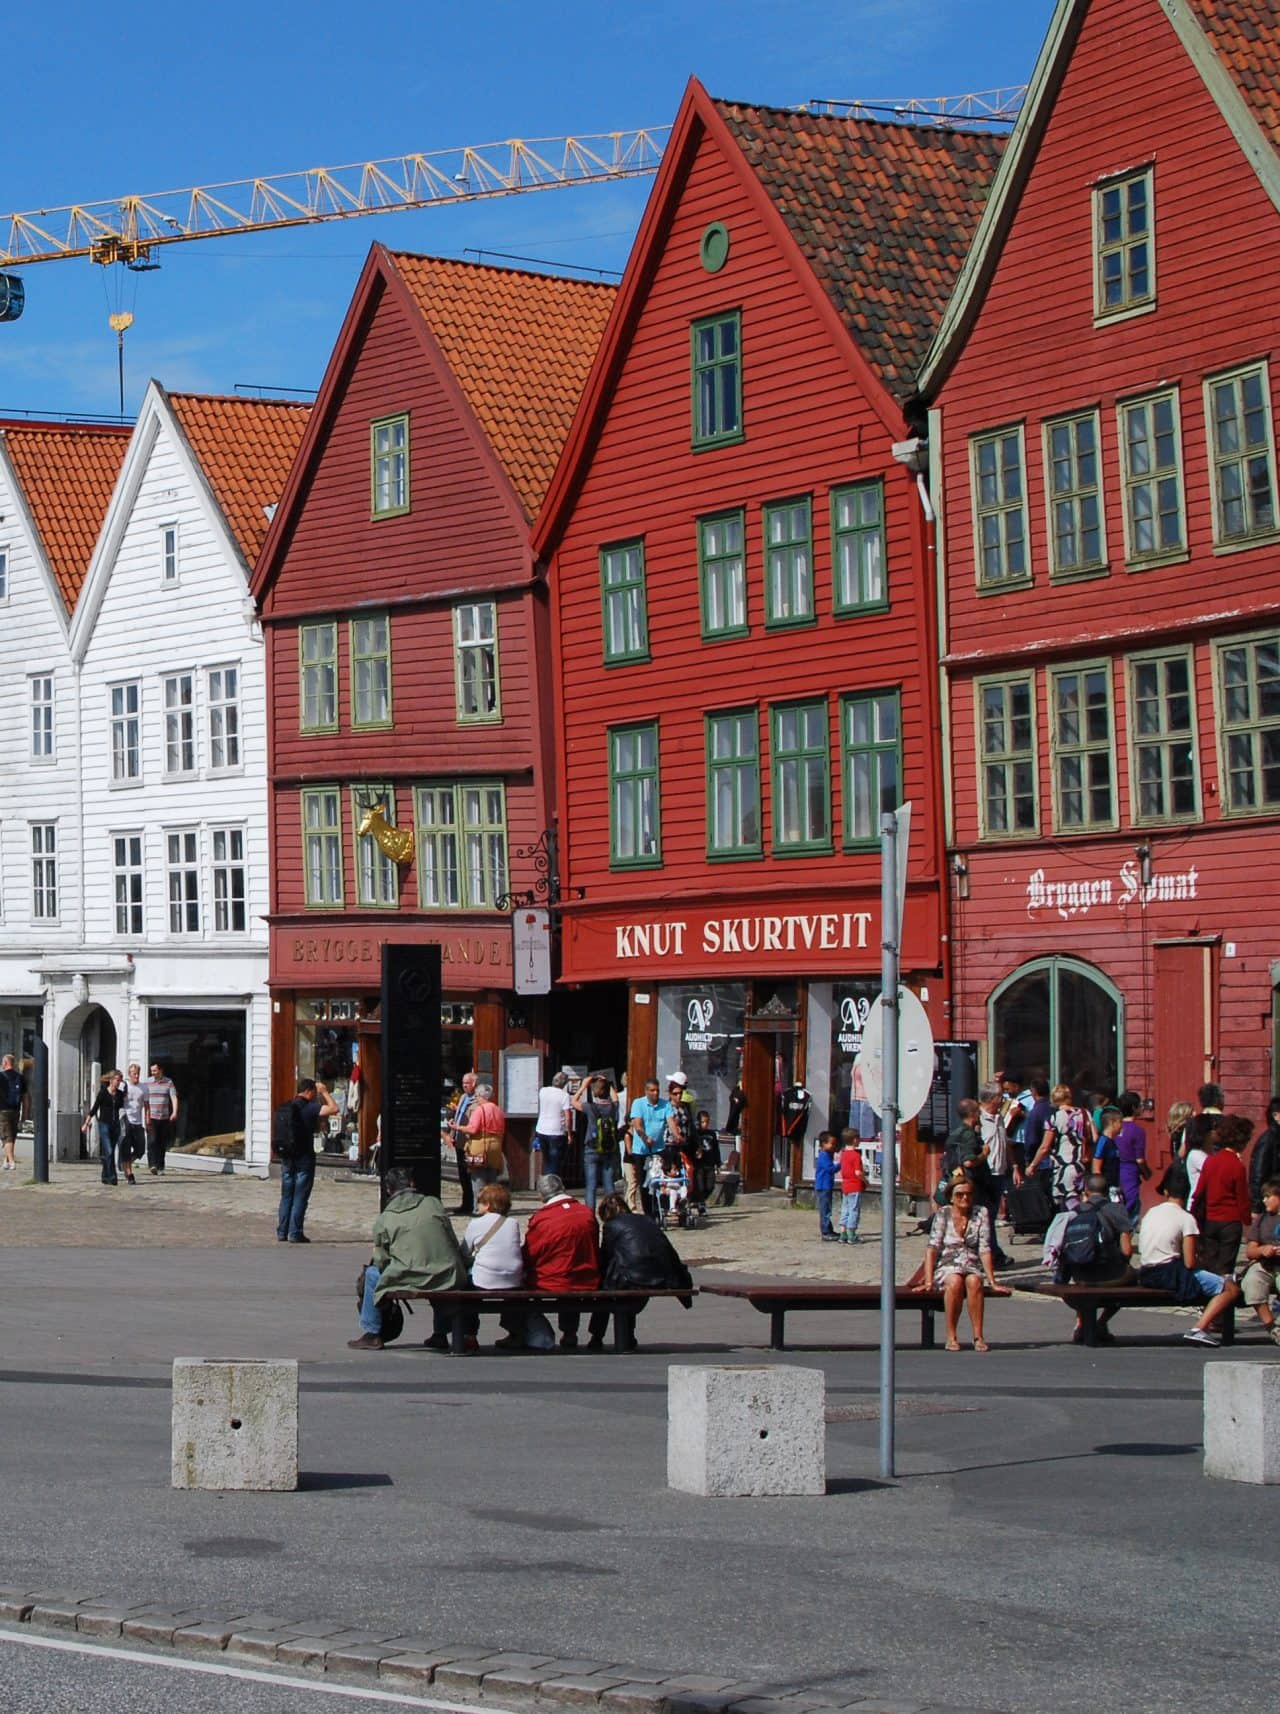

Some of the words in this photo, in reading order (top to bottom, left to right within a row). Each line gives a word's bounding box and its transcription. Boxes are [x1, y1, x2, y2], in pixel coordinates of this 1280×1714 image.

[1026, 868, 1112, 920] Bryggen
[616, 922, 687, 958] KNUT
[702, 912, 872, 954] SKURTVEIT
[687, 1041, 707, 1050] VIKEN
[837, 1033, 863, 1043] AUDHIL
